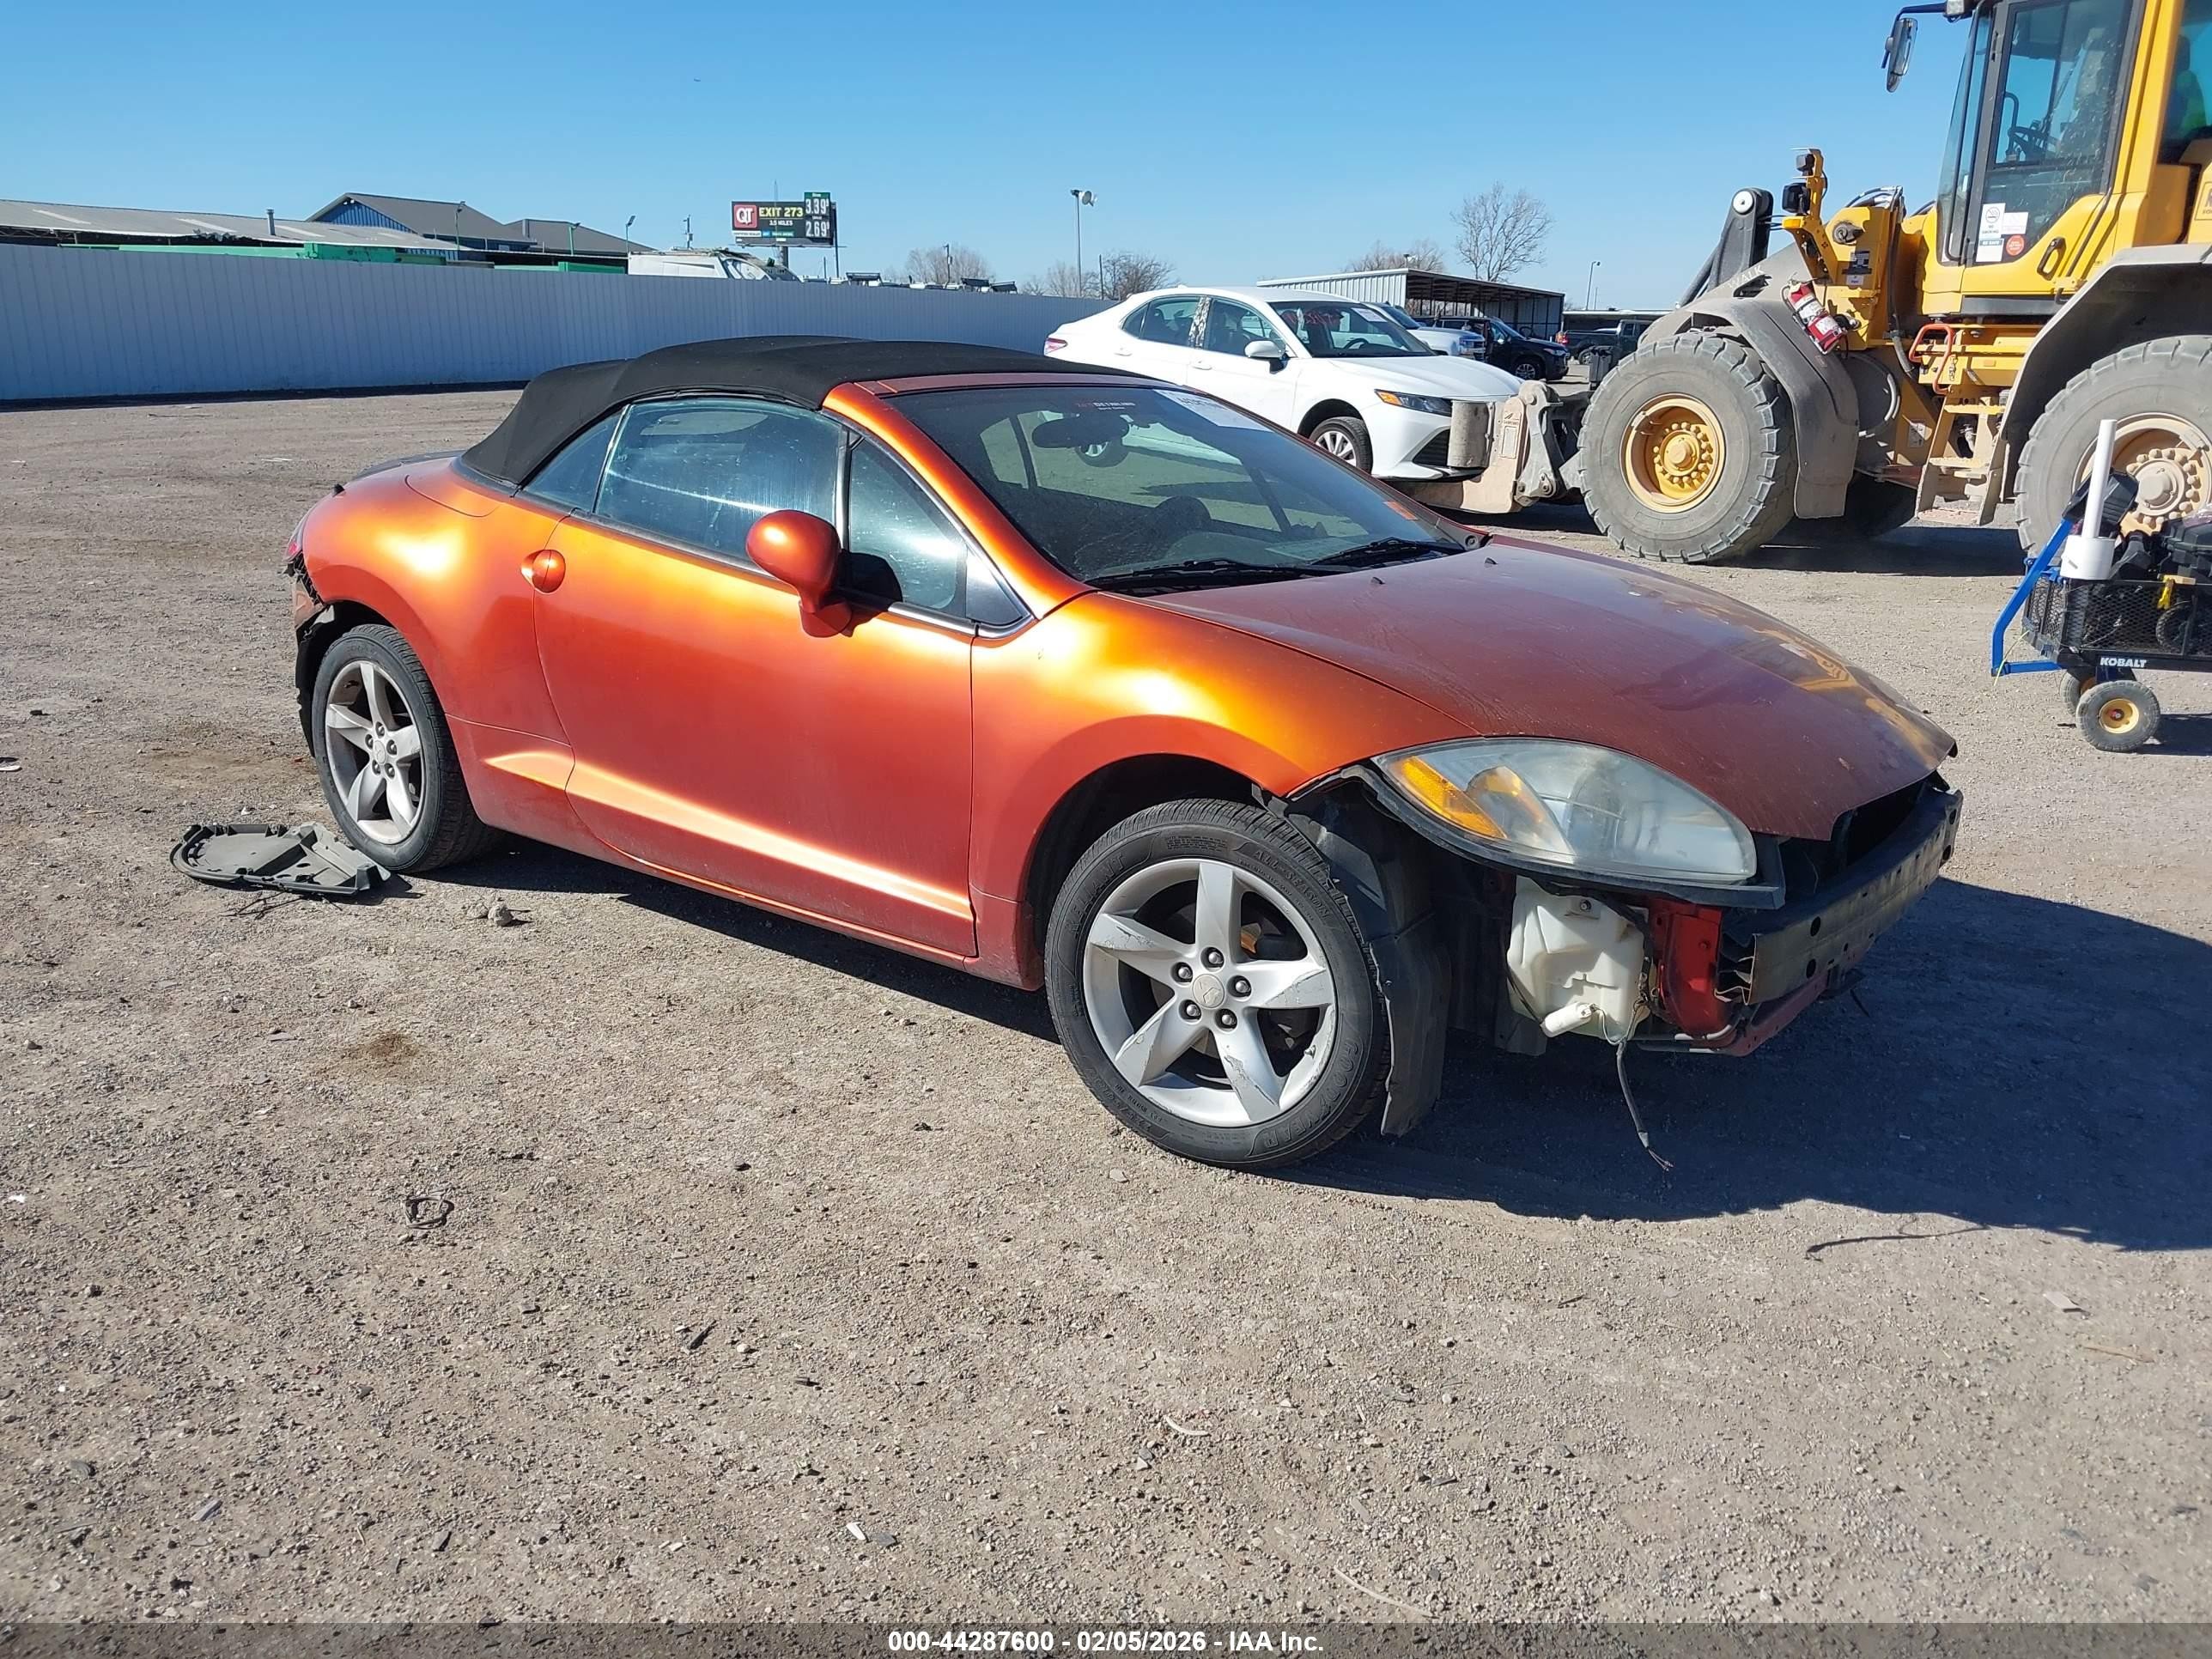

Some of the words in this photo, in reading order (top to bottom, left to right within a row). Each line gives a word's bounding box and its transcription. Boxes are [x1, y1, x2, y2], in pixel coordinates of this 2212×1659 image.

[736, 208, 753, 225] QT
[759, 207, 781, 217] EXIT
[784, 207, 804, 217] 273
[1728, 265, 1765, 289] WALK
[2100, 657, 2147, 668] KOBALT
[1065, 854, 1127, 936] RELIANT
[1264, 1040, 1359, 1148] GOODYEAR
